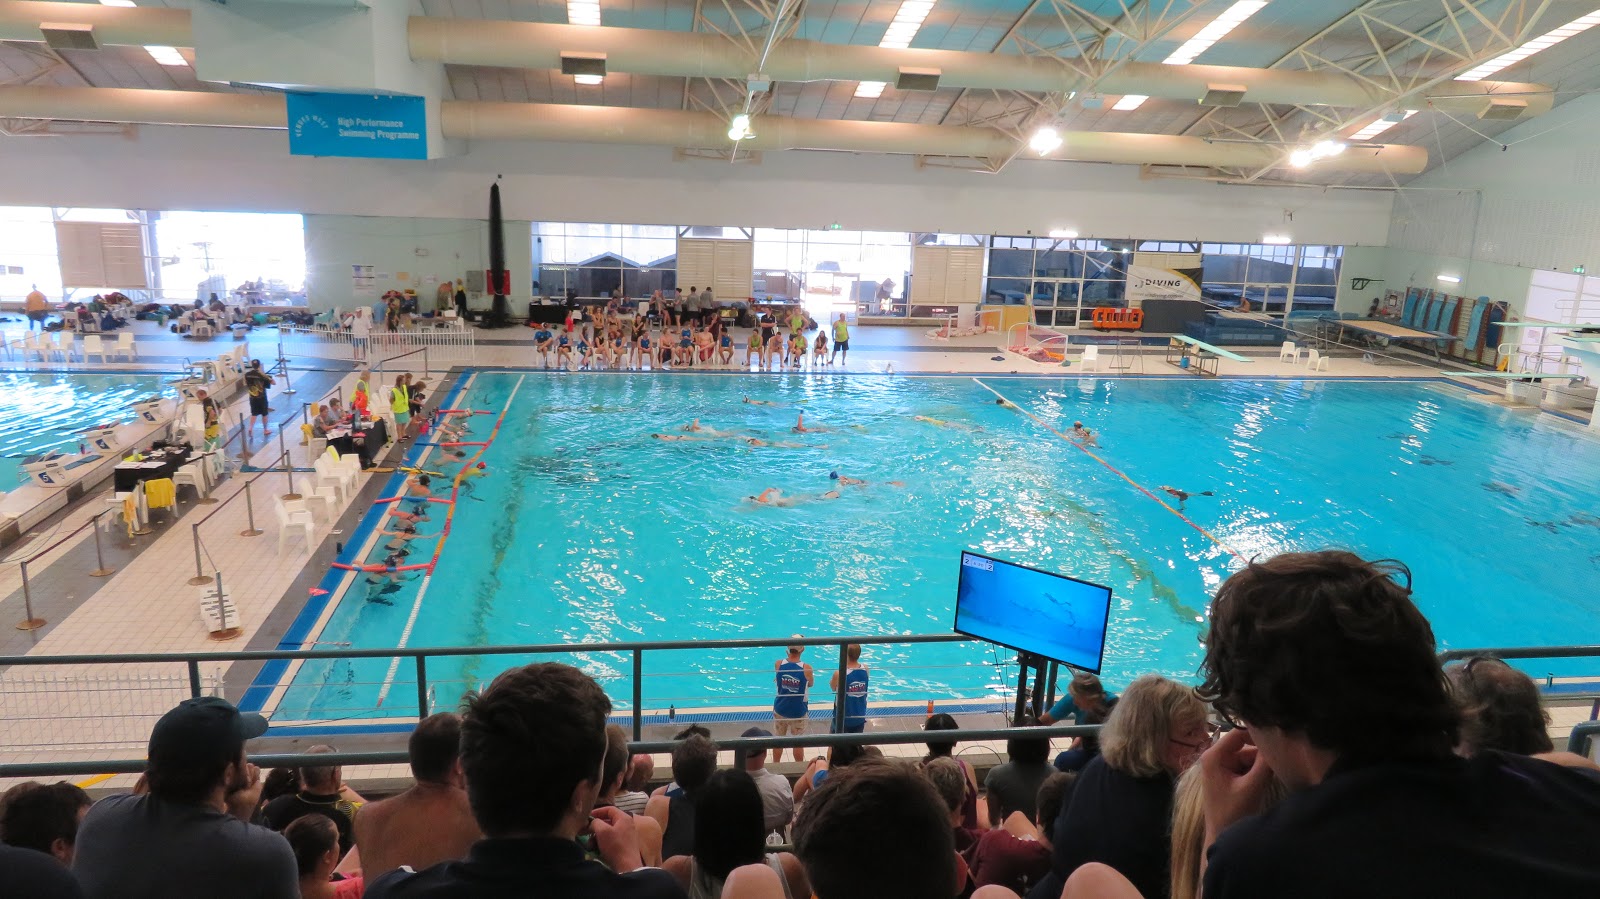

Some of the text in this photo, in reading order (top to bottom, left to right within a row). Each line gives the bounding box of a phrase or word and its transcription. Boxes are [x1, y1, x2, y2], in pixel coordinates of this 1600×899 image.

[312, 115, 329, 129] WEST
[337, 117, 404, 128] High Performance
[339, 128, 420, 140] Swimming Programme
[1145, 278, 1181, 287] DIVING
